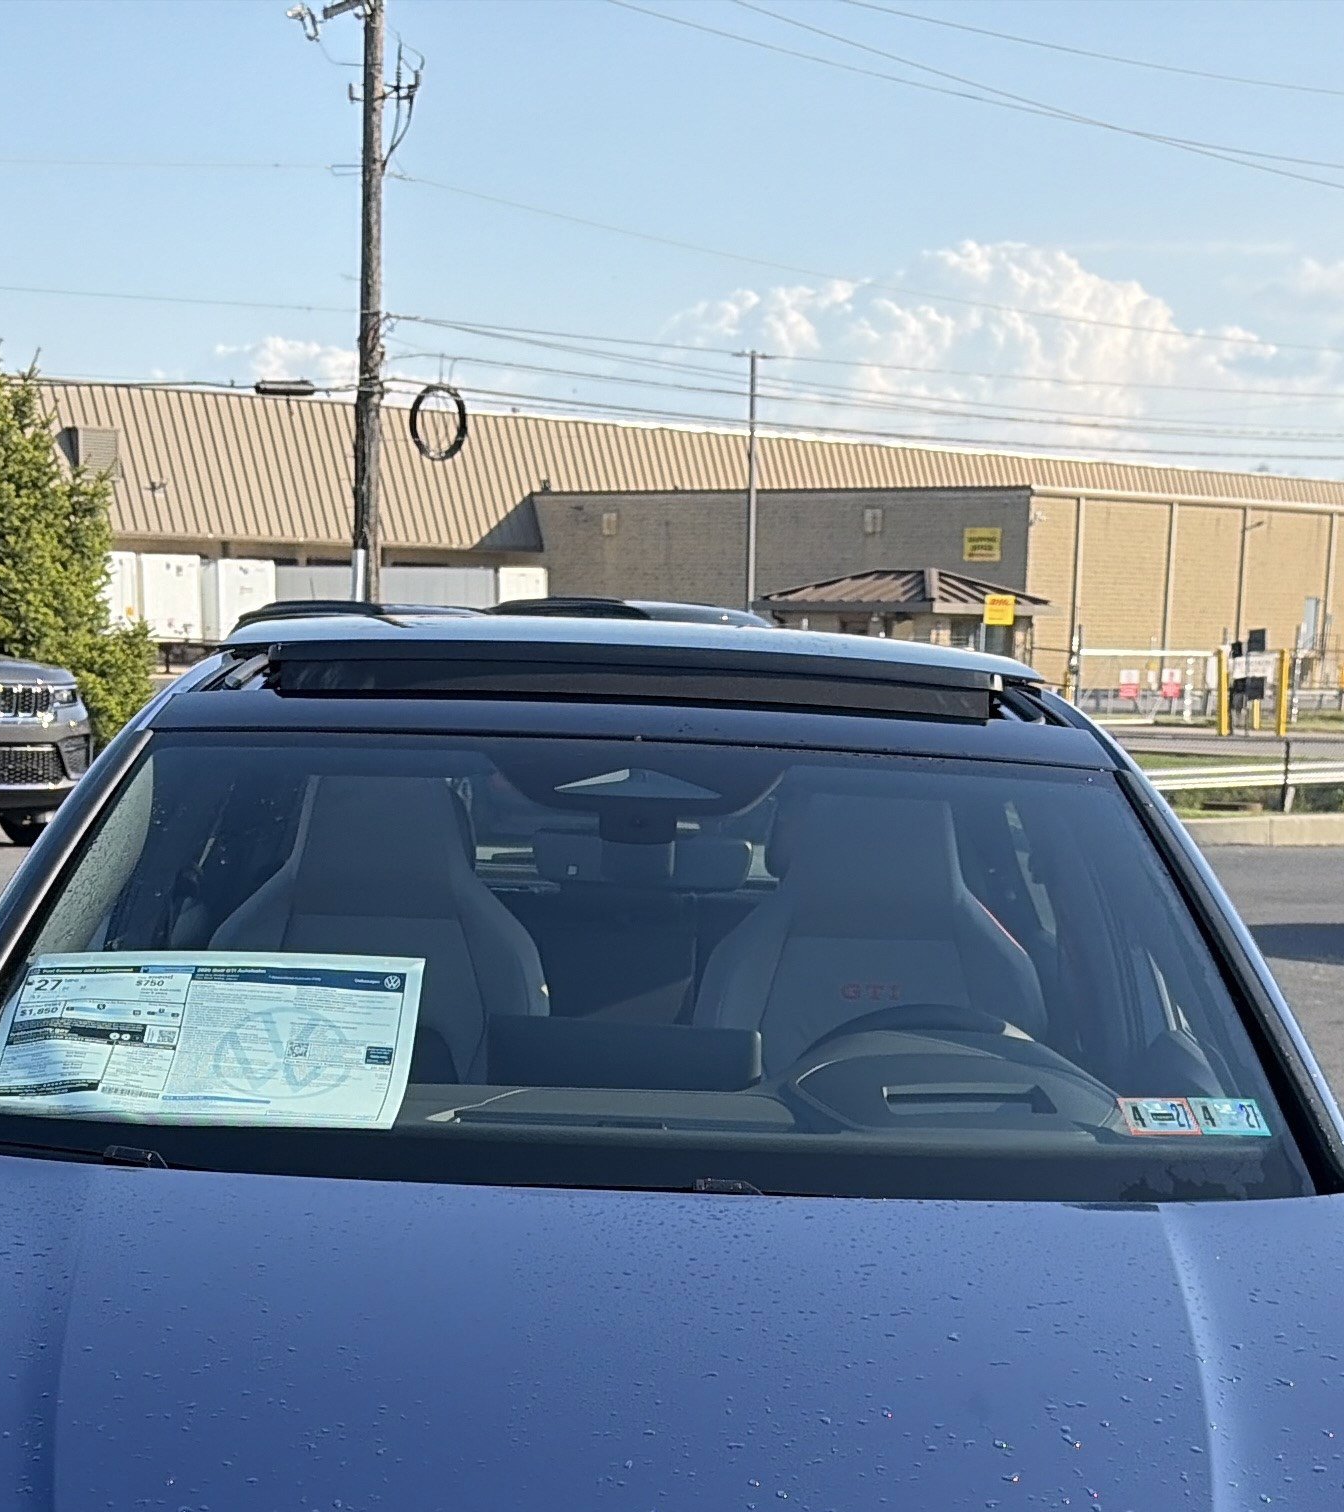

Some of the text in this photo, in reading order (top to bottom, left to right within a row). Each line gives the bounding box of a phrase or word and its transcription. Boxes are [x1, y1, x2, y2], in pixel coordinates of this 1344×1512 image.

[34, 979, 63, 991] 27
[135, 979, 165, 987] $750
[1130, 1105, 1147, 1128] 4
[1201, 1105, 1217, 1128] 4
